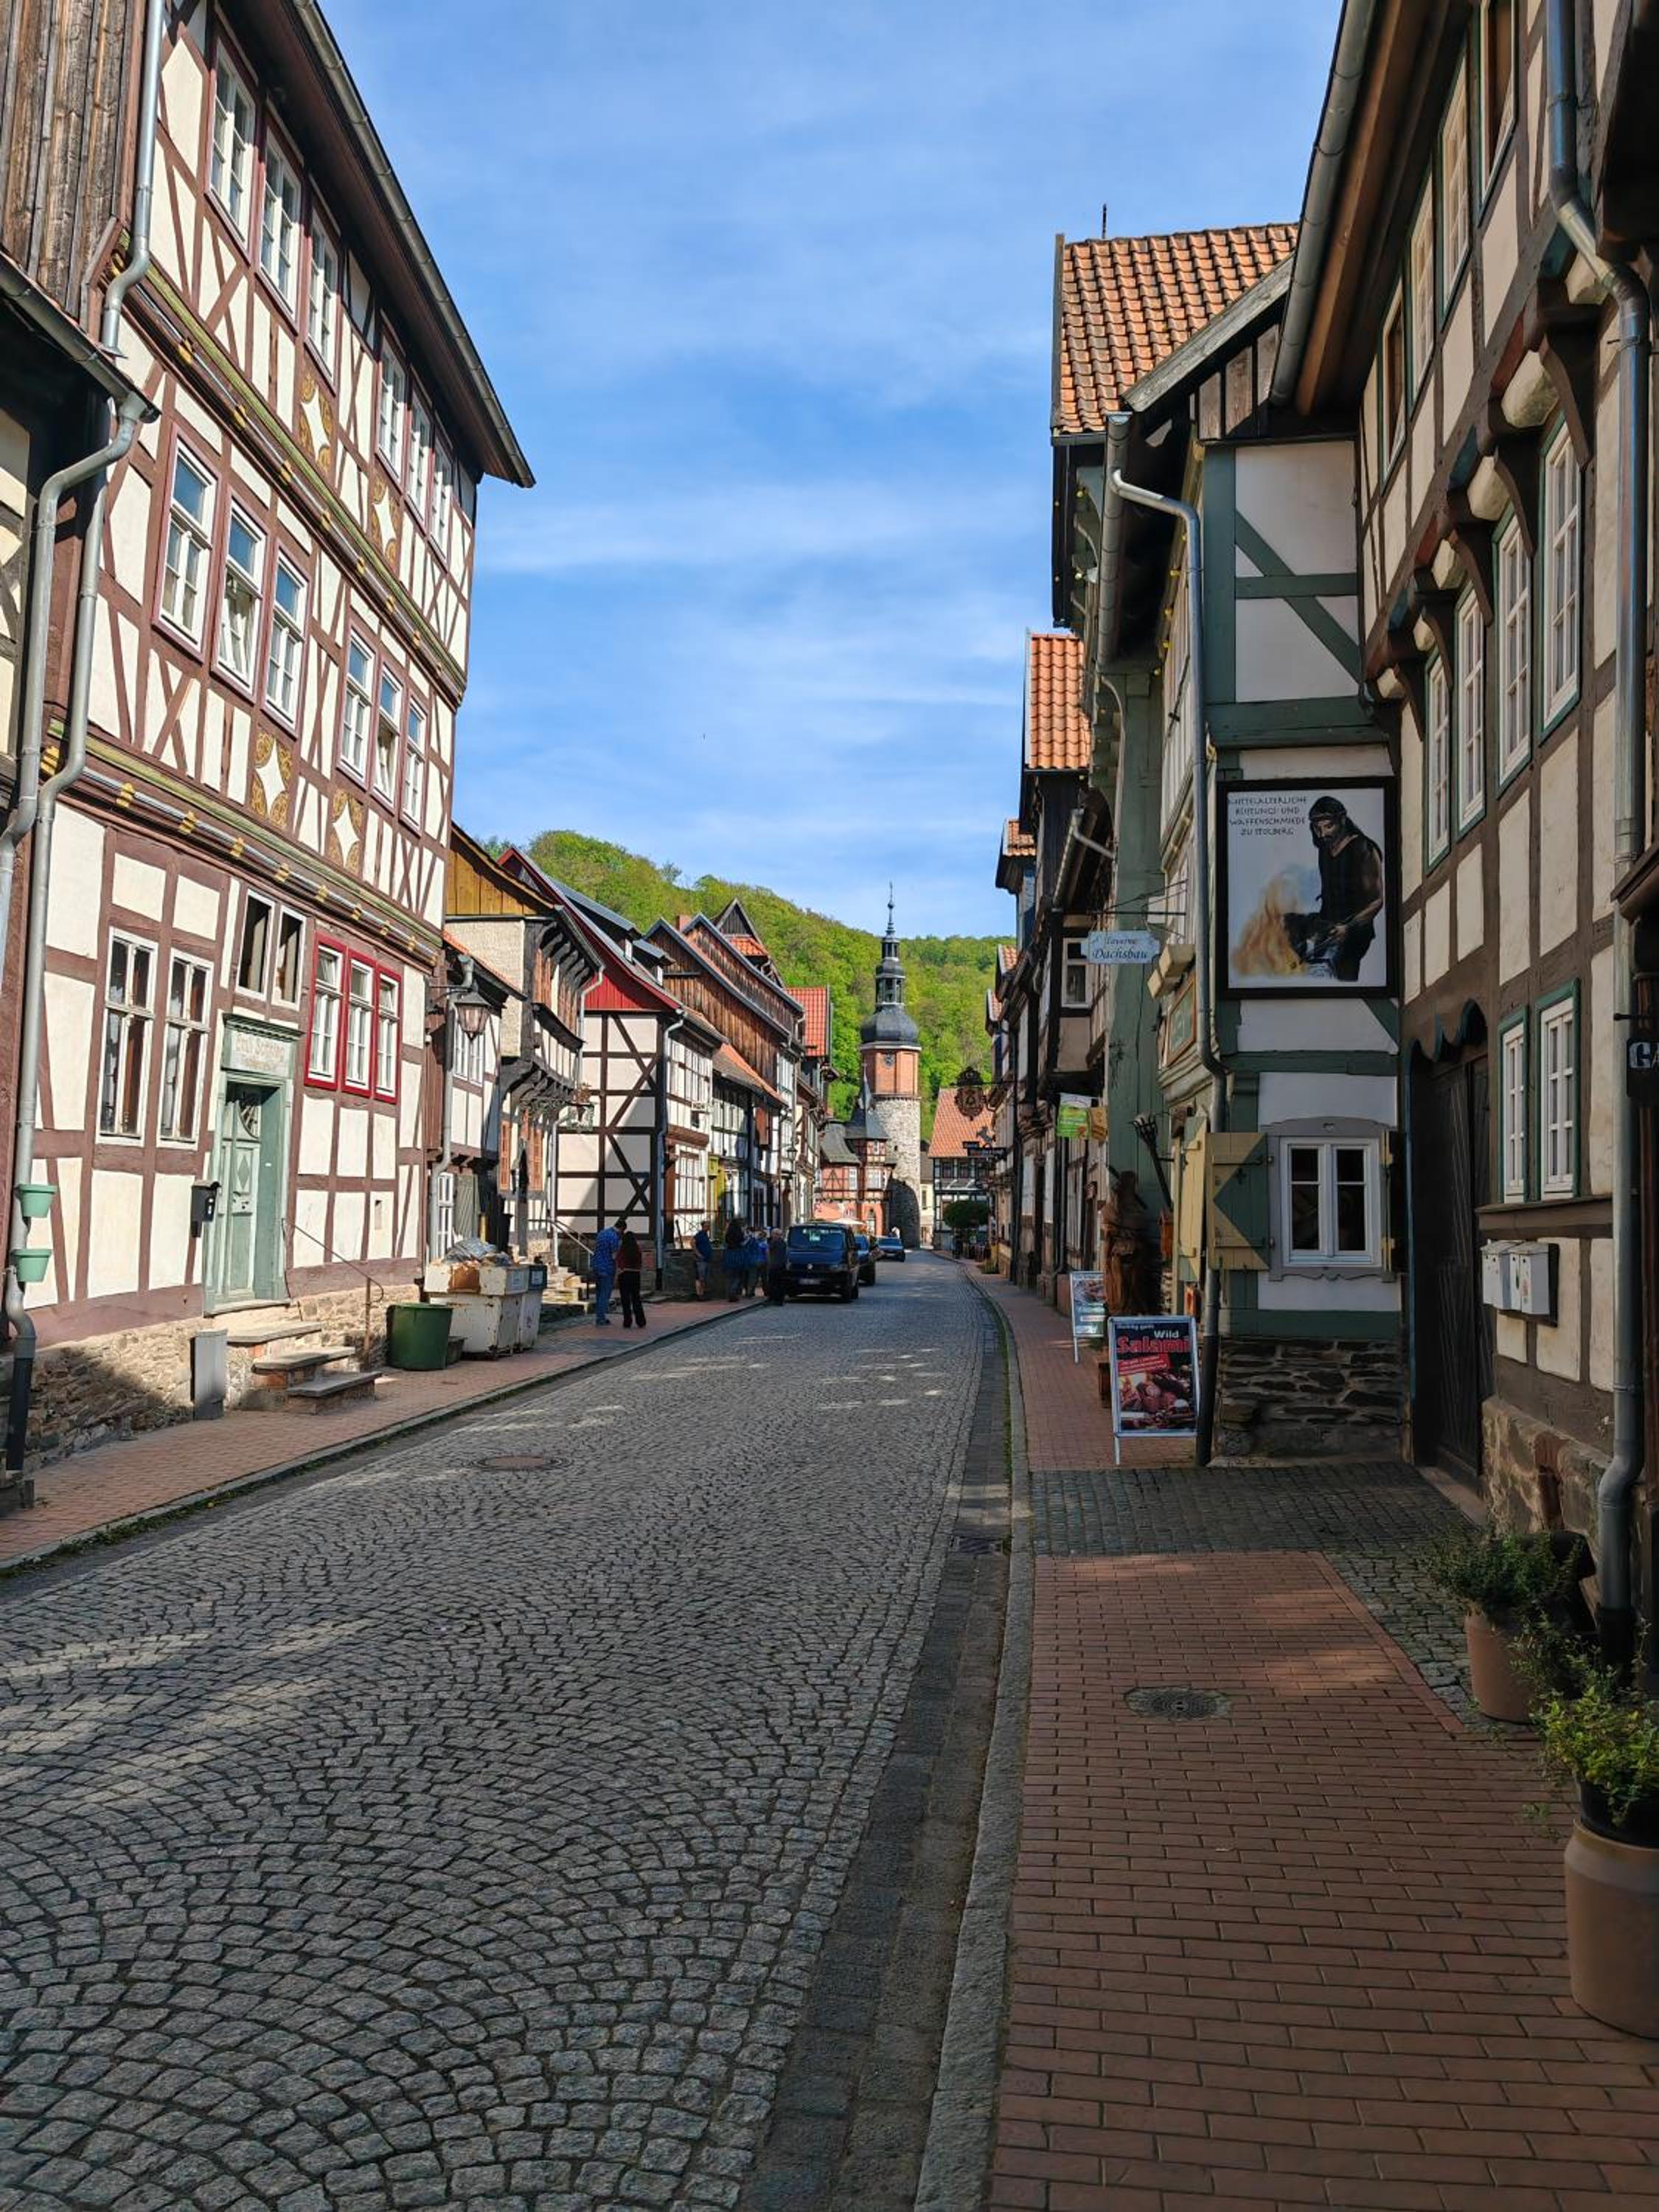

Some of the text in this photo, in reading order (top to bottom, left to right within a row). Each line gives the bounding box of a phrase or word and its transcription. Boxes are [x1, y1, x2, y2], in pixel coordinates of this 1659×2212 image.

[1281, 807, 1300, 815] UND
[1229, 817, 1305, 826] WAFFENSCHMIEDE
[1154, 1329, 1179, 1338] Wild
[1117, 1335, 1191, 1353] Salami
